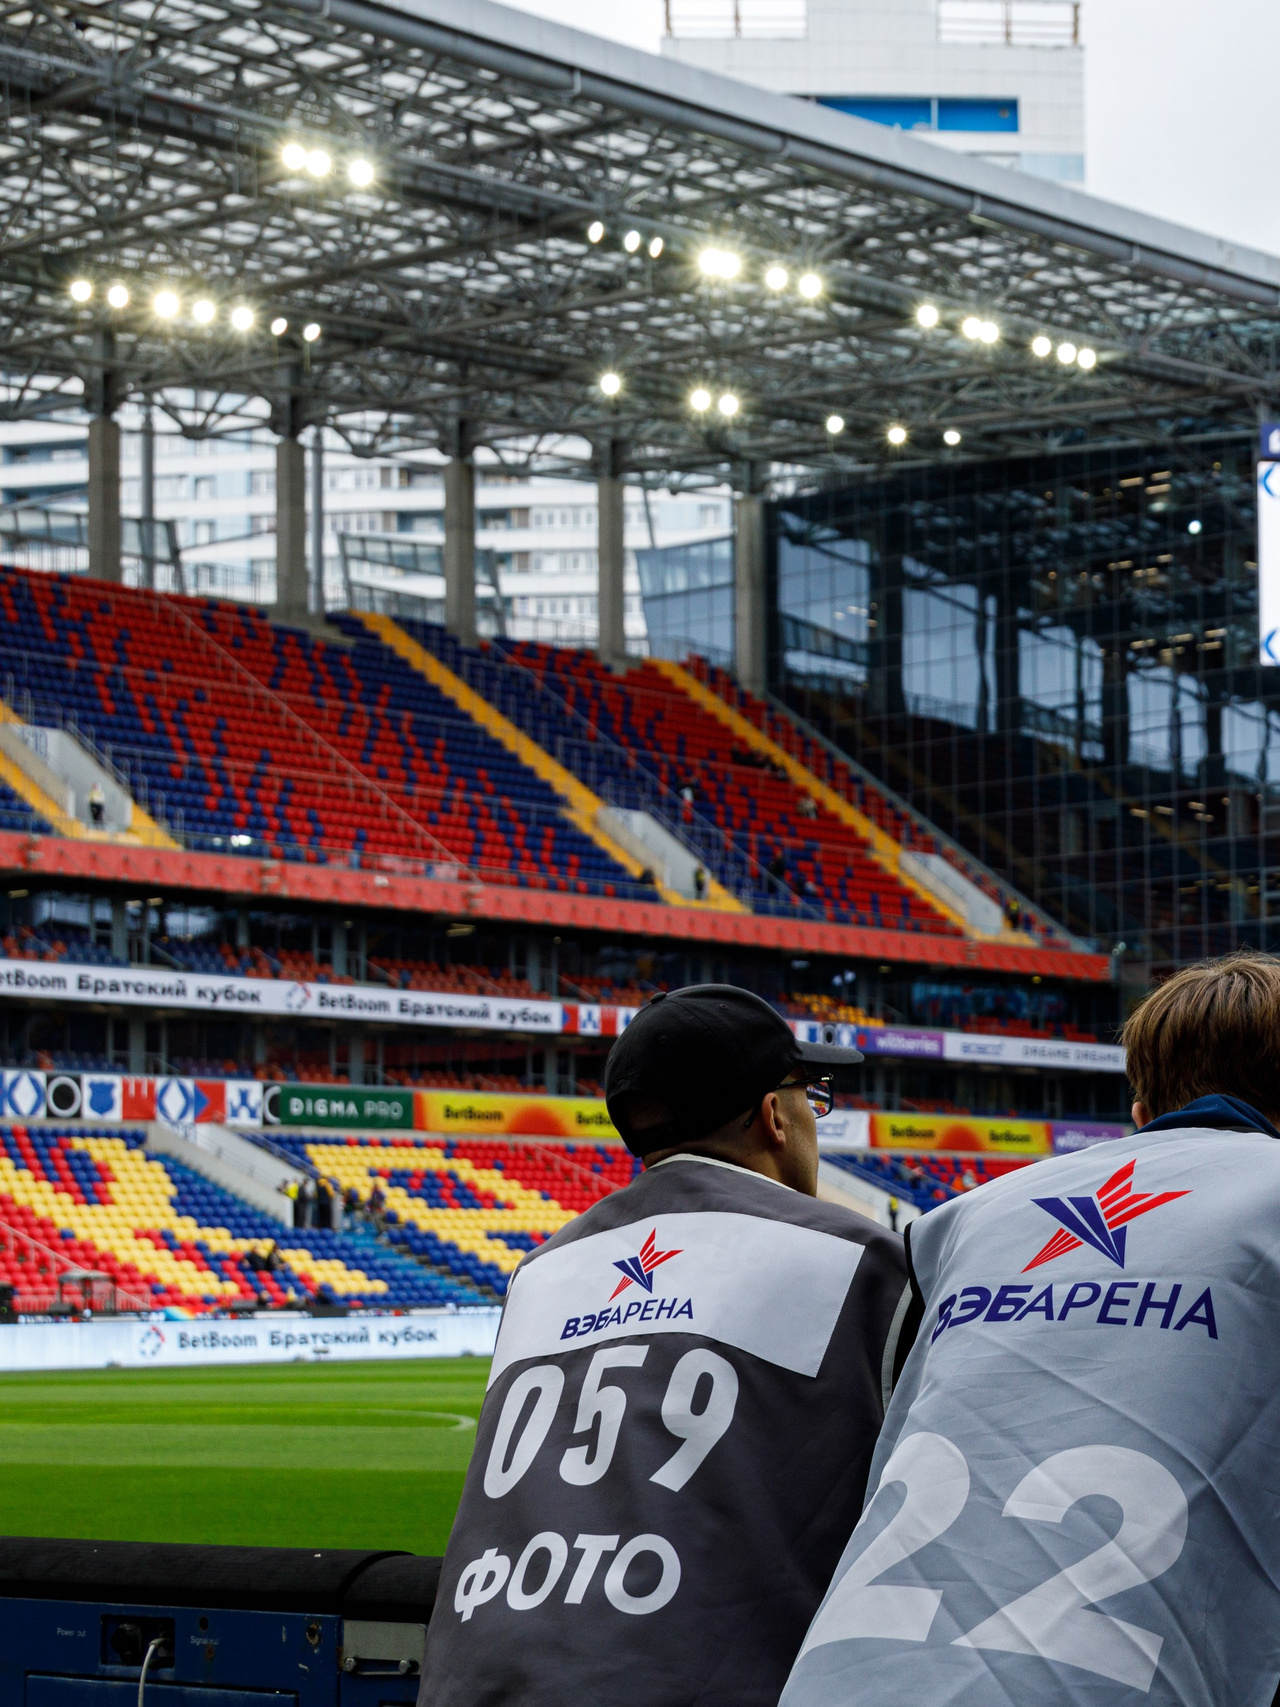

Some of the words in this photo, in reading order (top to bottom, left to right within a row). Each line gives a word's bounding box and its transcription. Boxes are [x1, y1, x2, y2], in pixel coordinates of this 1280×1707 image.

[78, 974, 188, 997] Братский
[197, 984, 261, 1005] кубок
[318, 991, 391, 1013] BetBoom
[400, 998, 491, 1019] Братский
[498, 1008, 553, 1028] кубок
[290, 1098, 357, 1118] DIGMA
[363, 1100, 404, 1120] PRO
[444, 1105, 505, 1122] BetBoom
[890, 1124, 936, 1140] BetBoom
[989, 1130, 1032, 1144] BetBoom
[560, 1298, 694, 1341] ВЭБАРЕНА
[931, 1281, 1219, 1347] ВЭБАРЕНА
[179, 1331, 257, 1349] BetBoom
[270, 1327, 370, 1349] Братский
[378, 1326, 438, 1346] кубок
[484, 1344, 739, 1499] 059
[454, 1531, 682, 1623] ФОТО
[794, 1431, 1189, 1693] 22
[57, 1627, 75, 1637] Power
